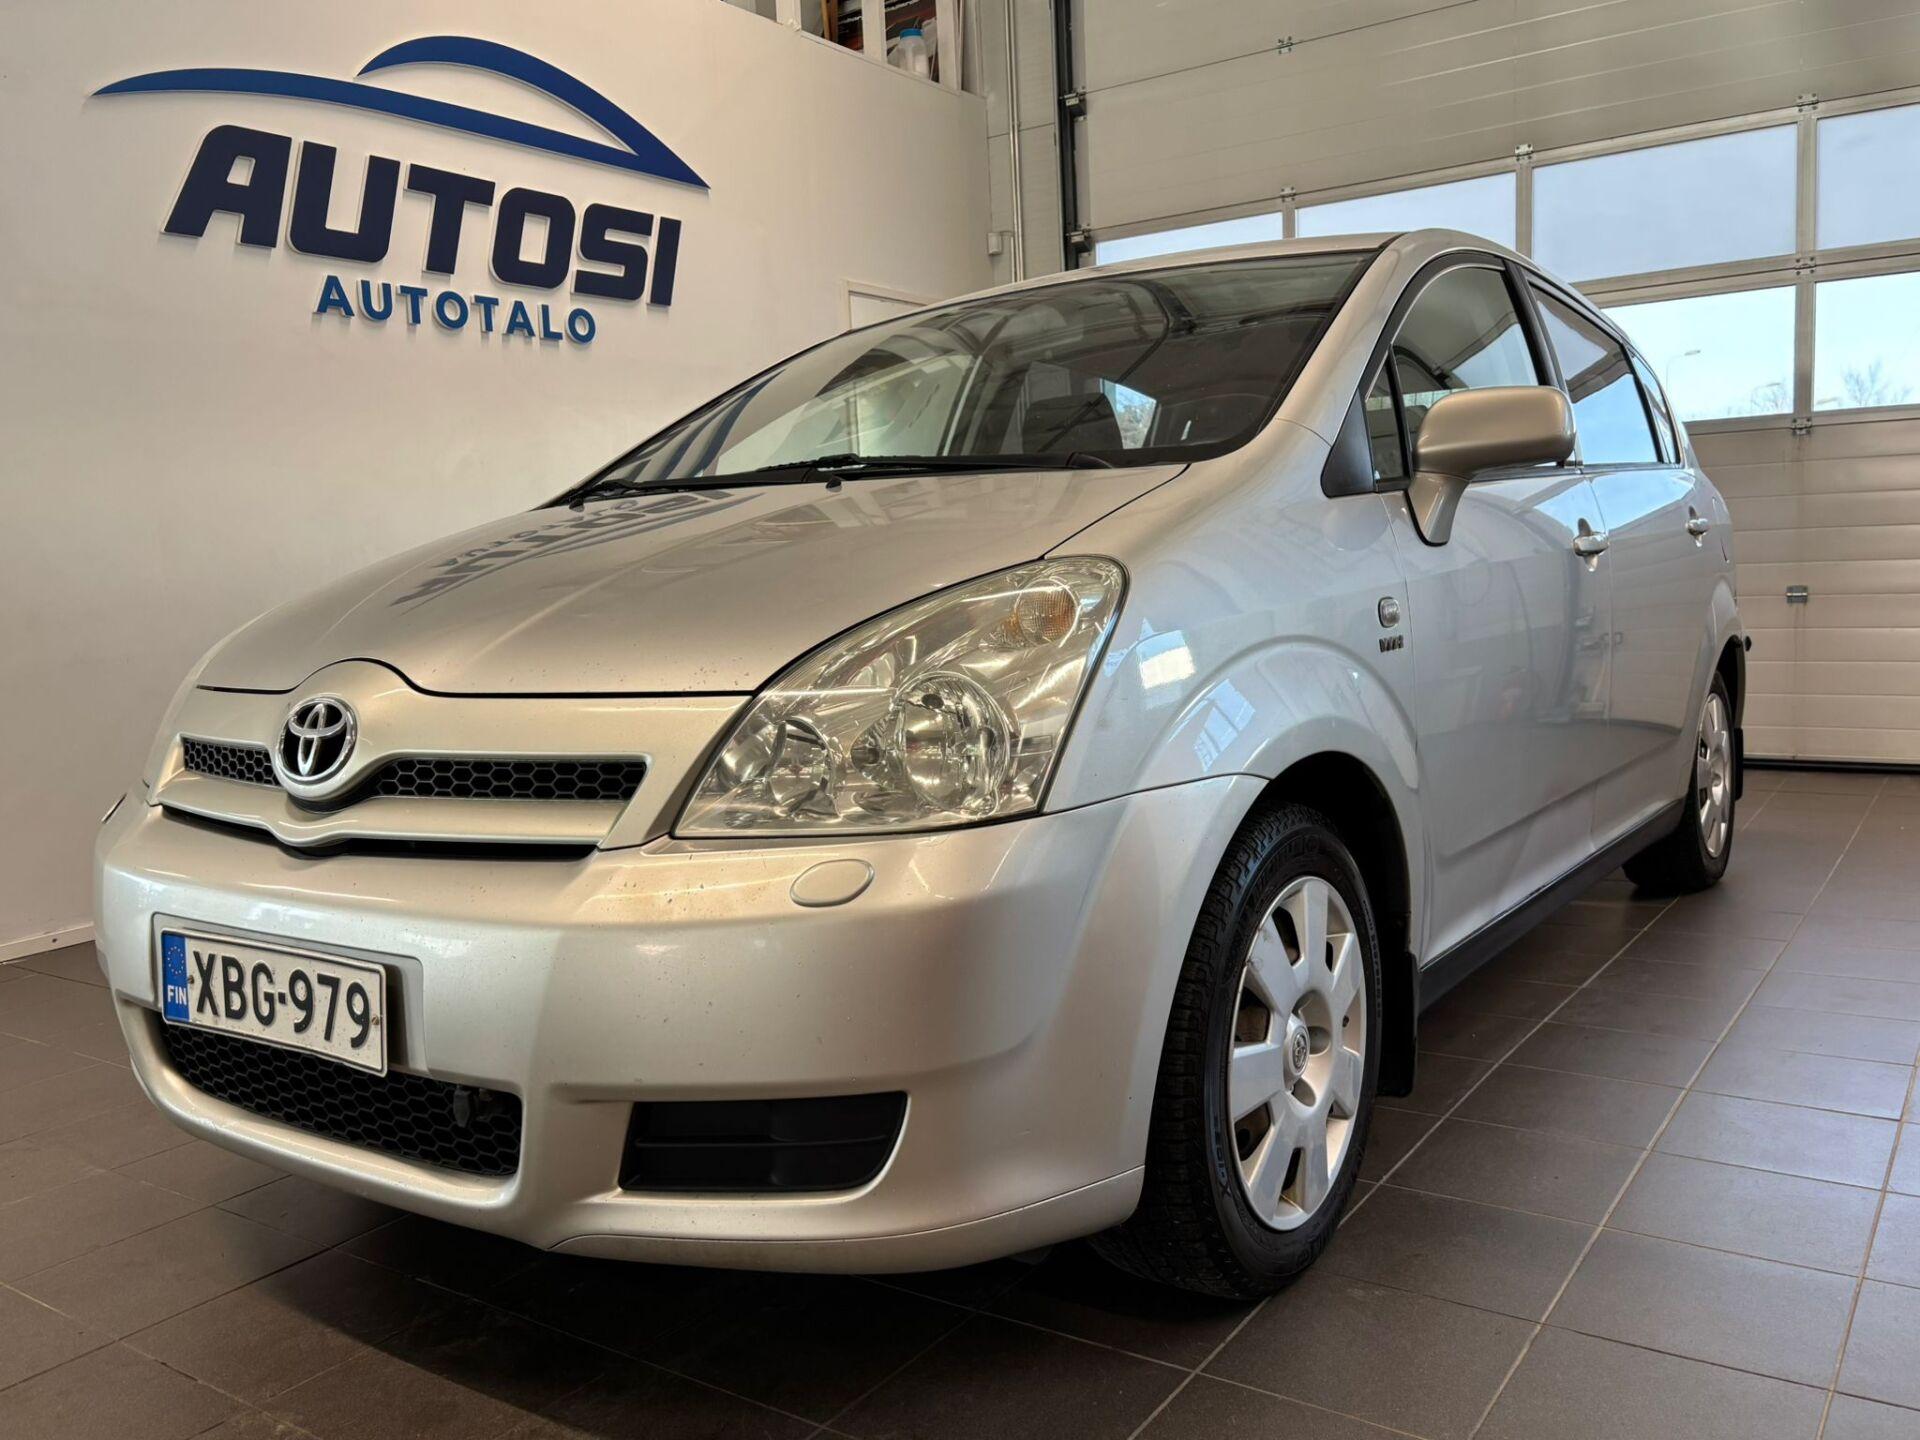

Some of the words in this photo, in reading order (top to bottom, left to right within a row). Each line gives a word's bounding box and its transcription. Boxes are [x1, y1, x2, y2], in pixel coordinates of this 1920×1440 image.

[164, 124, 682, 307] AUTOSI
[316, 275, 597, 344] AUTOTALO
[167, 984, 189, 1007] FIN
[192, 950, 371, 1049] XBG-979
